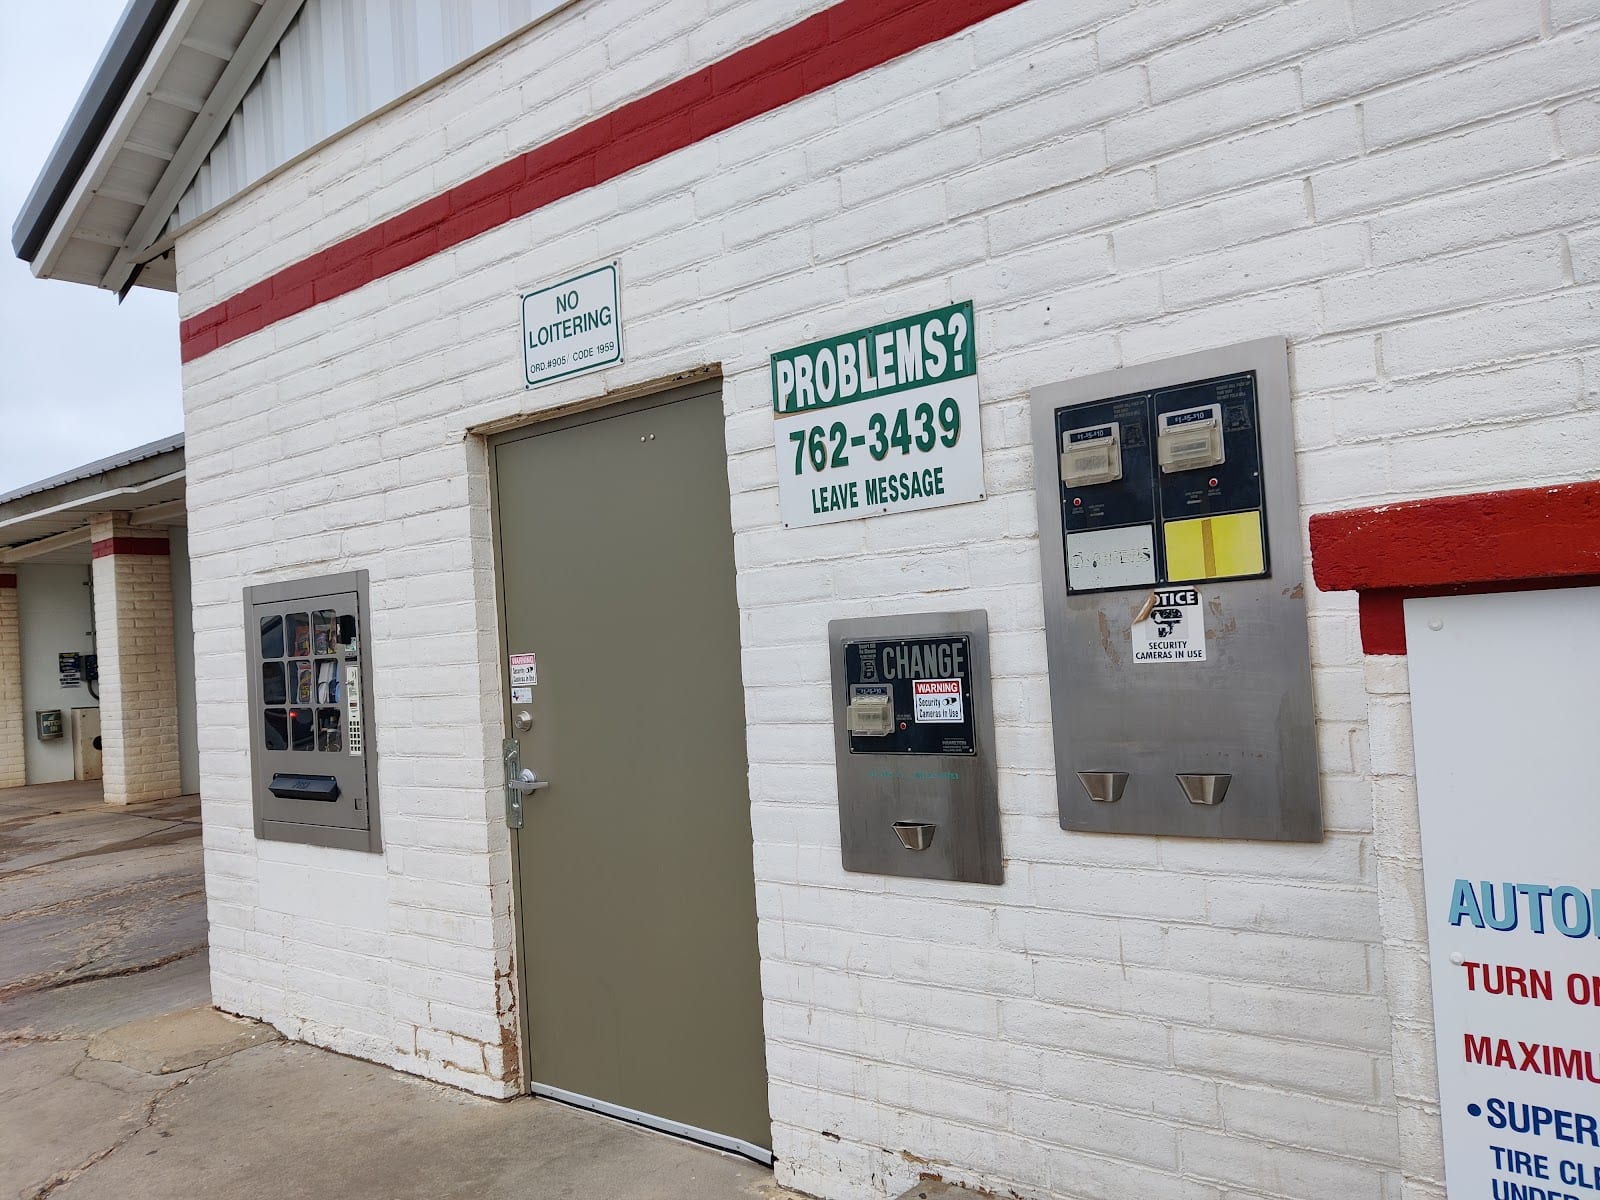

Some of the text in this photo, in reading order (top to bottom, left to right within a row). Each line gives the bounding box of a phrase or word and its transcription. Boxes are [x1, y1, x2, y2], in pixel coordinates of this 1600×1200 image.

[556, 290, 579, 315] NO
[529, 306, 612, 349] LOITERING
[572, 347, 594, 362] CODE
[596, 341, 615, 355] 1959
[776, 312, 967, 412] PROBLEMS?
[789, 397, 961, 475] 762-3439
[811, 466, 945, 514] LEAVE MESSAGE
[1153, 591, 1196, 606] TICE
[882, 642, 965, 680] CHANGE
[1135, 649, 1203, 660] CAMERAS IN USE
[1148, 640, 1187, 650] SECURITY
[917, 682, 958, 694] WARNING
[918, 697, 941, 708] Security
[919, 708, 941, 719] Cameras
[949, 708, 959, 719] Use
[1448, 879, 1600, 939] AUTO
[1461, 961, 1553, 1001] TURN
[1464, 1033, 1600, 1085] MAXIMU
[1486, 1098, 1600, 1147] SUPER
[1489, 1145, 1550, 1180] TIRE
[1492, 1178, 1580, 1200] UND
